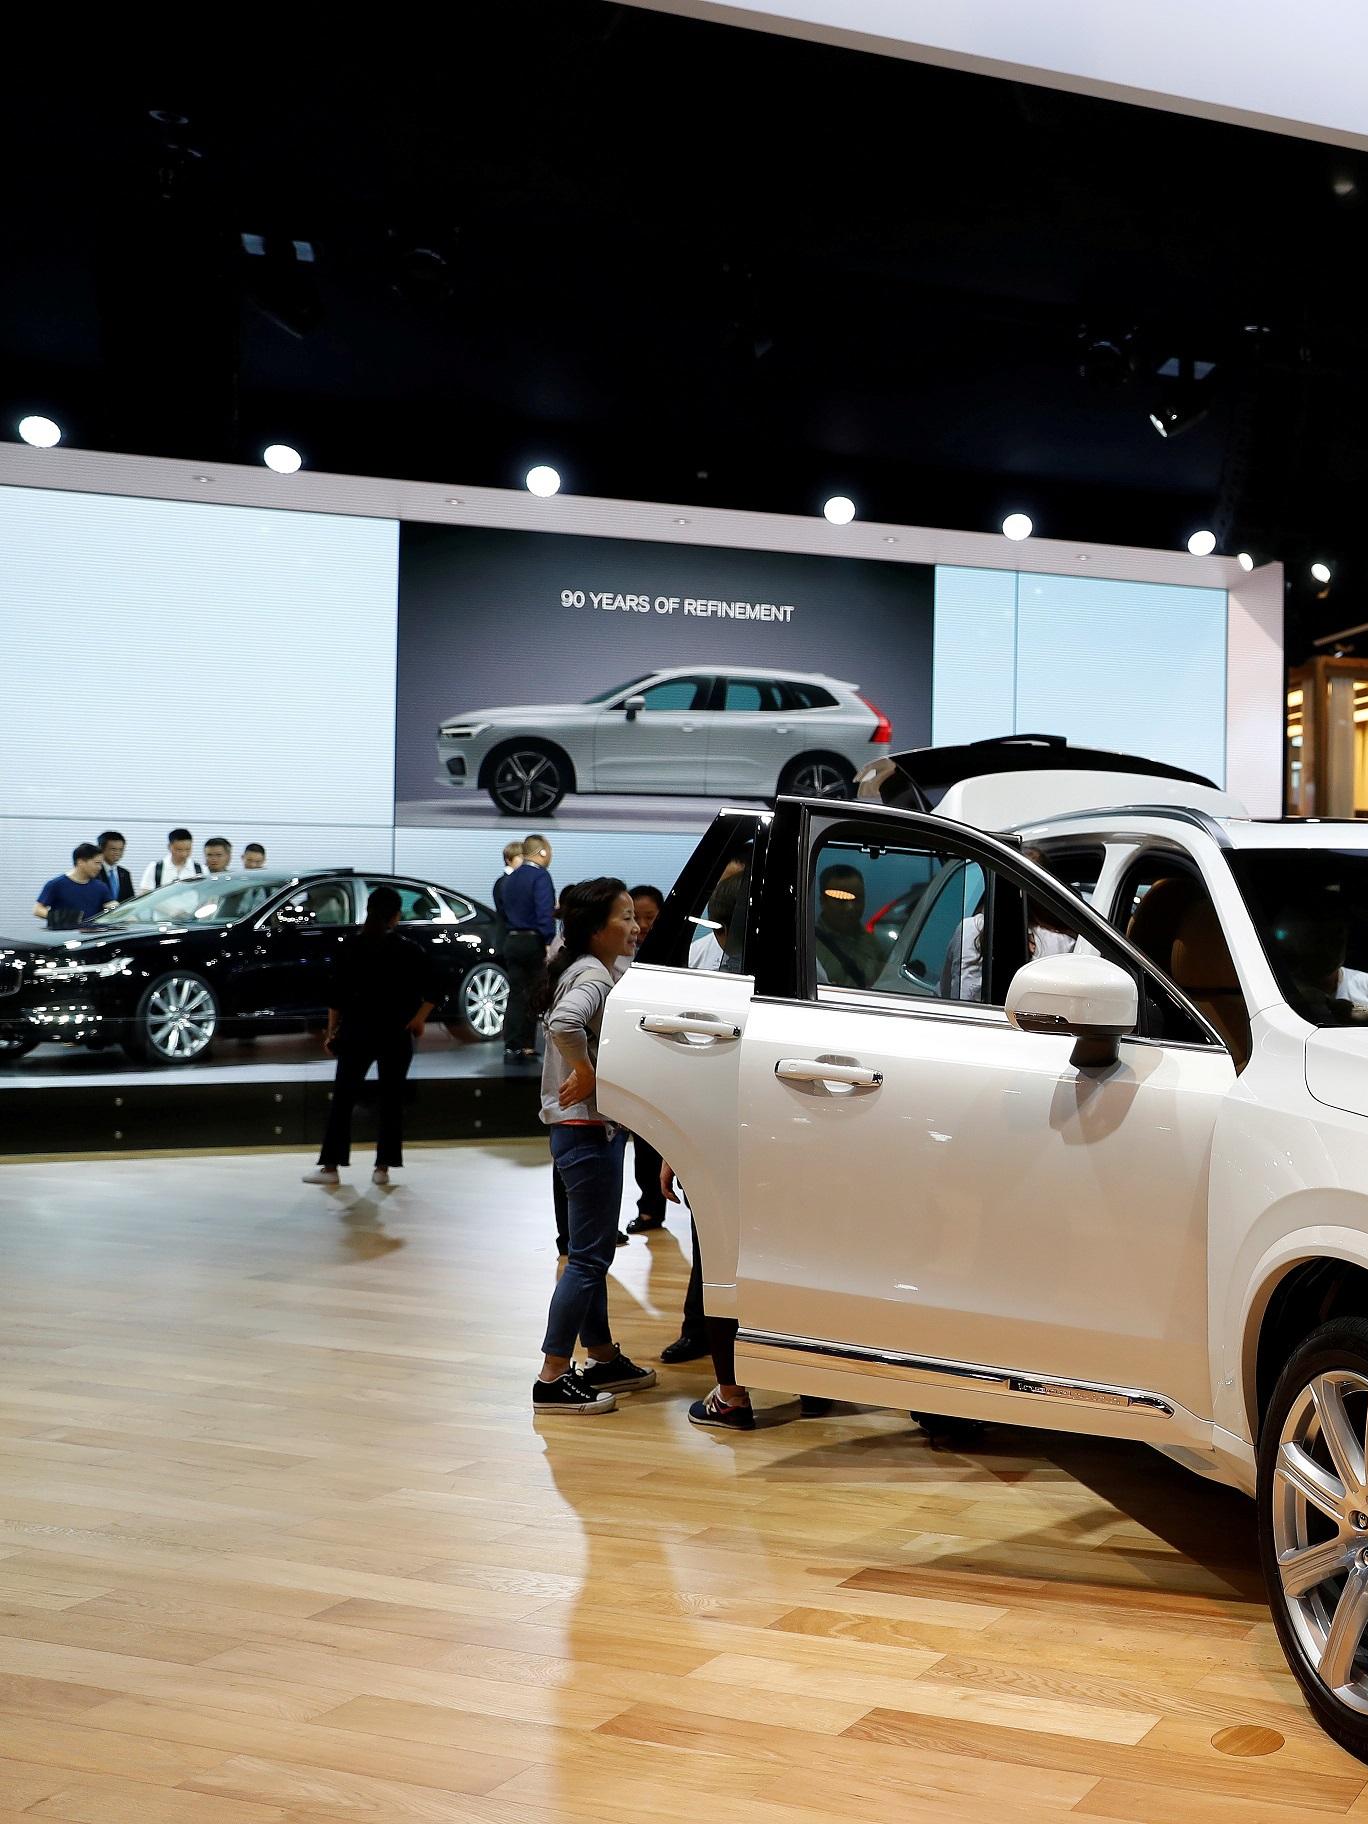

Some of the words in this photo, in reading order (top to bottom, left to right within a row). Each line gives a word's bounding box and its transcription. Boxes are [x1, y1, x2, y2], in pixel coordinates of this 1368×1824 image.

[560, 590, 586, 609] 90
[589, 591, 651, 613] YEARS
[654, 597, 680, 615] OF
[683, 599, 795, 623] REFINEMENT
